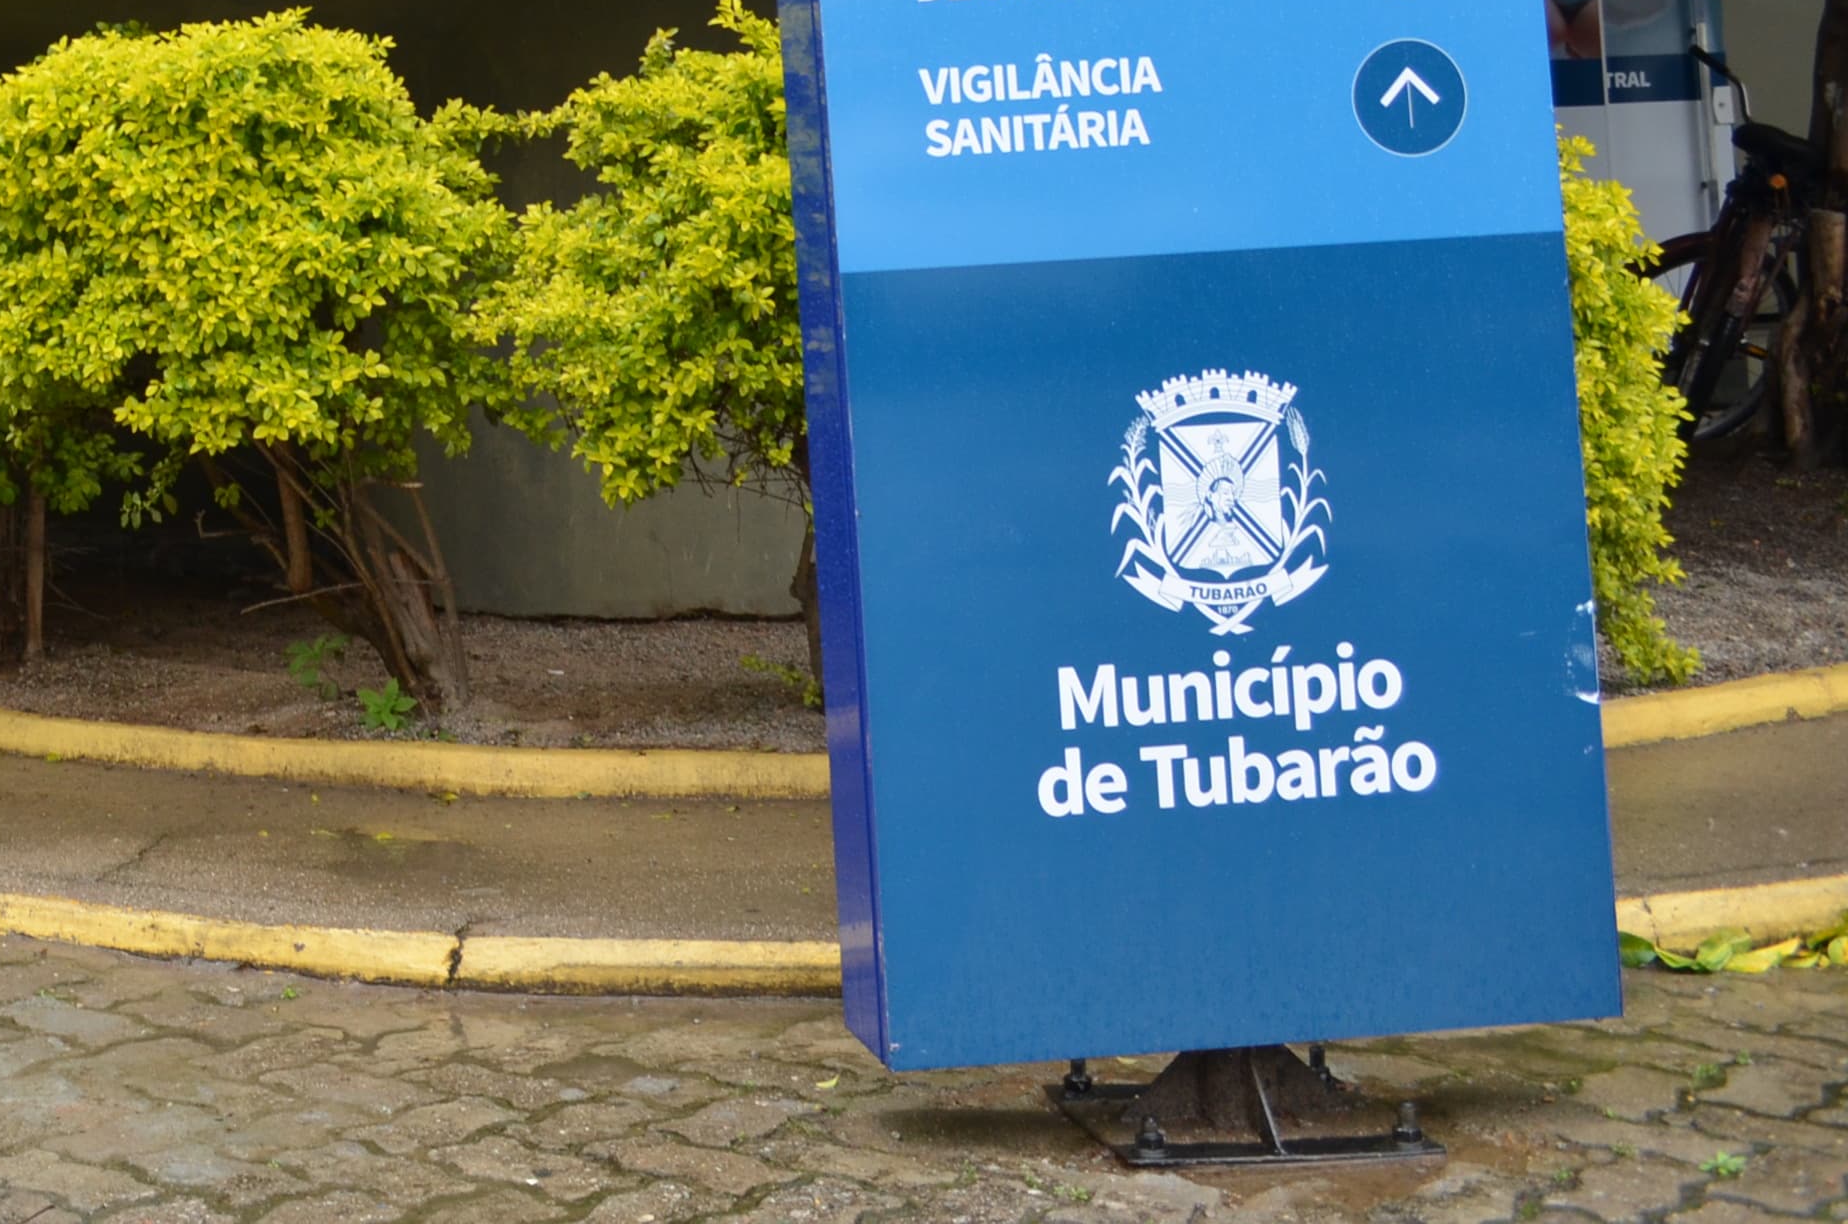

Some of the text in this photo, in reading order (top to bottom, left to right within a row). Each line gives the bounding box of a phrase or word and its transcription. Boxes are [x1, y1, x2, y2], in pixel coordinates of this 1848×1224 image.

[918, 53, 1163, 106] VIGILÂNCIA
[925, 104, 1151, 158] SANITÁRIA
[1056, 641, 1404, 732] Município
[1037, 724, 1437, 818] de Tubarão
